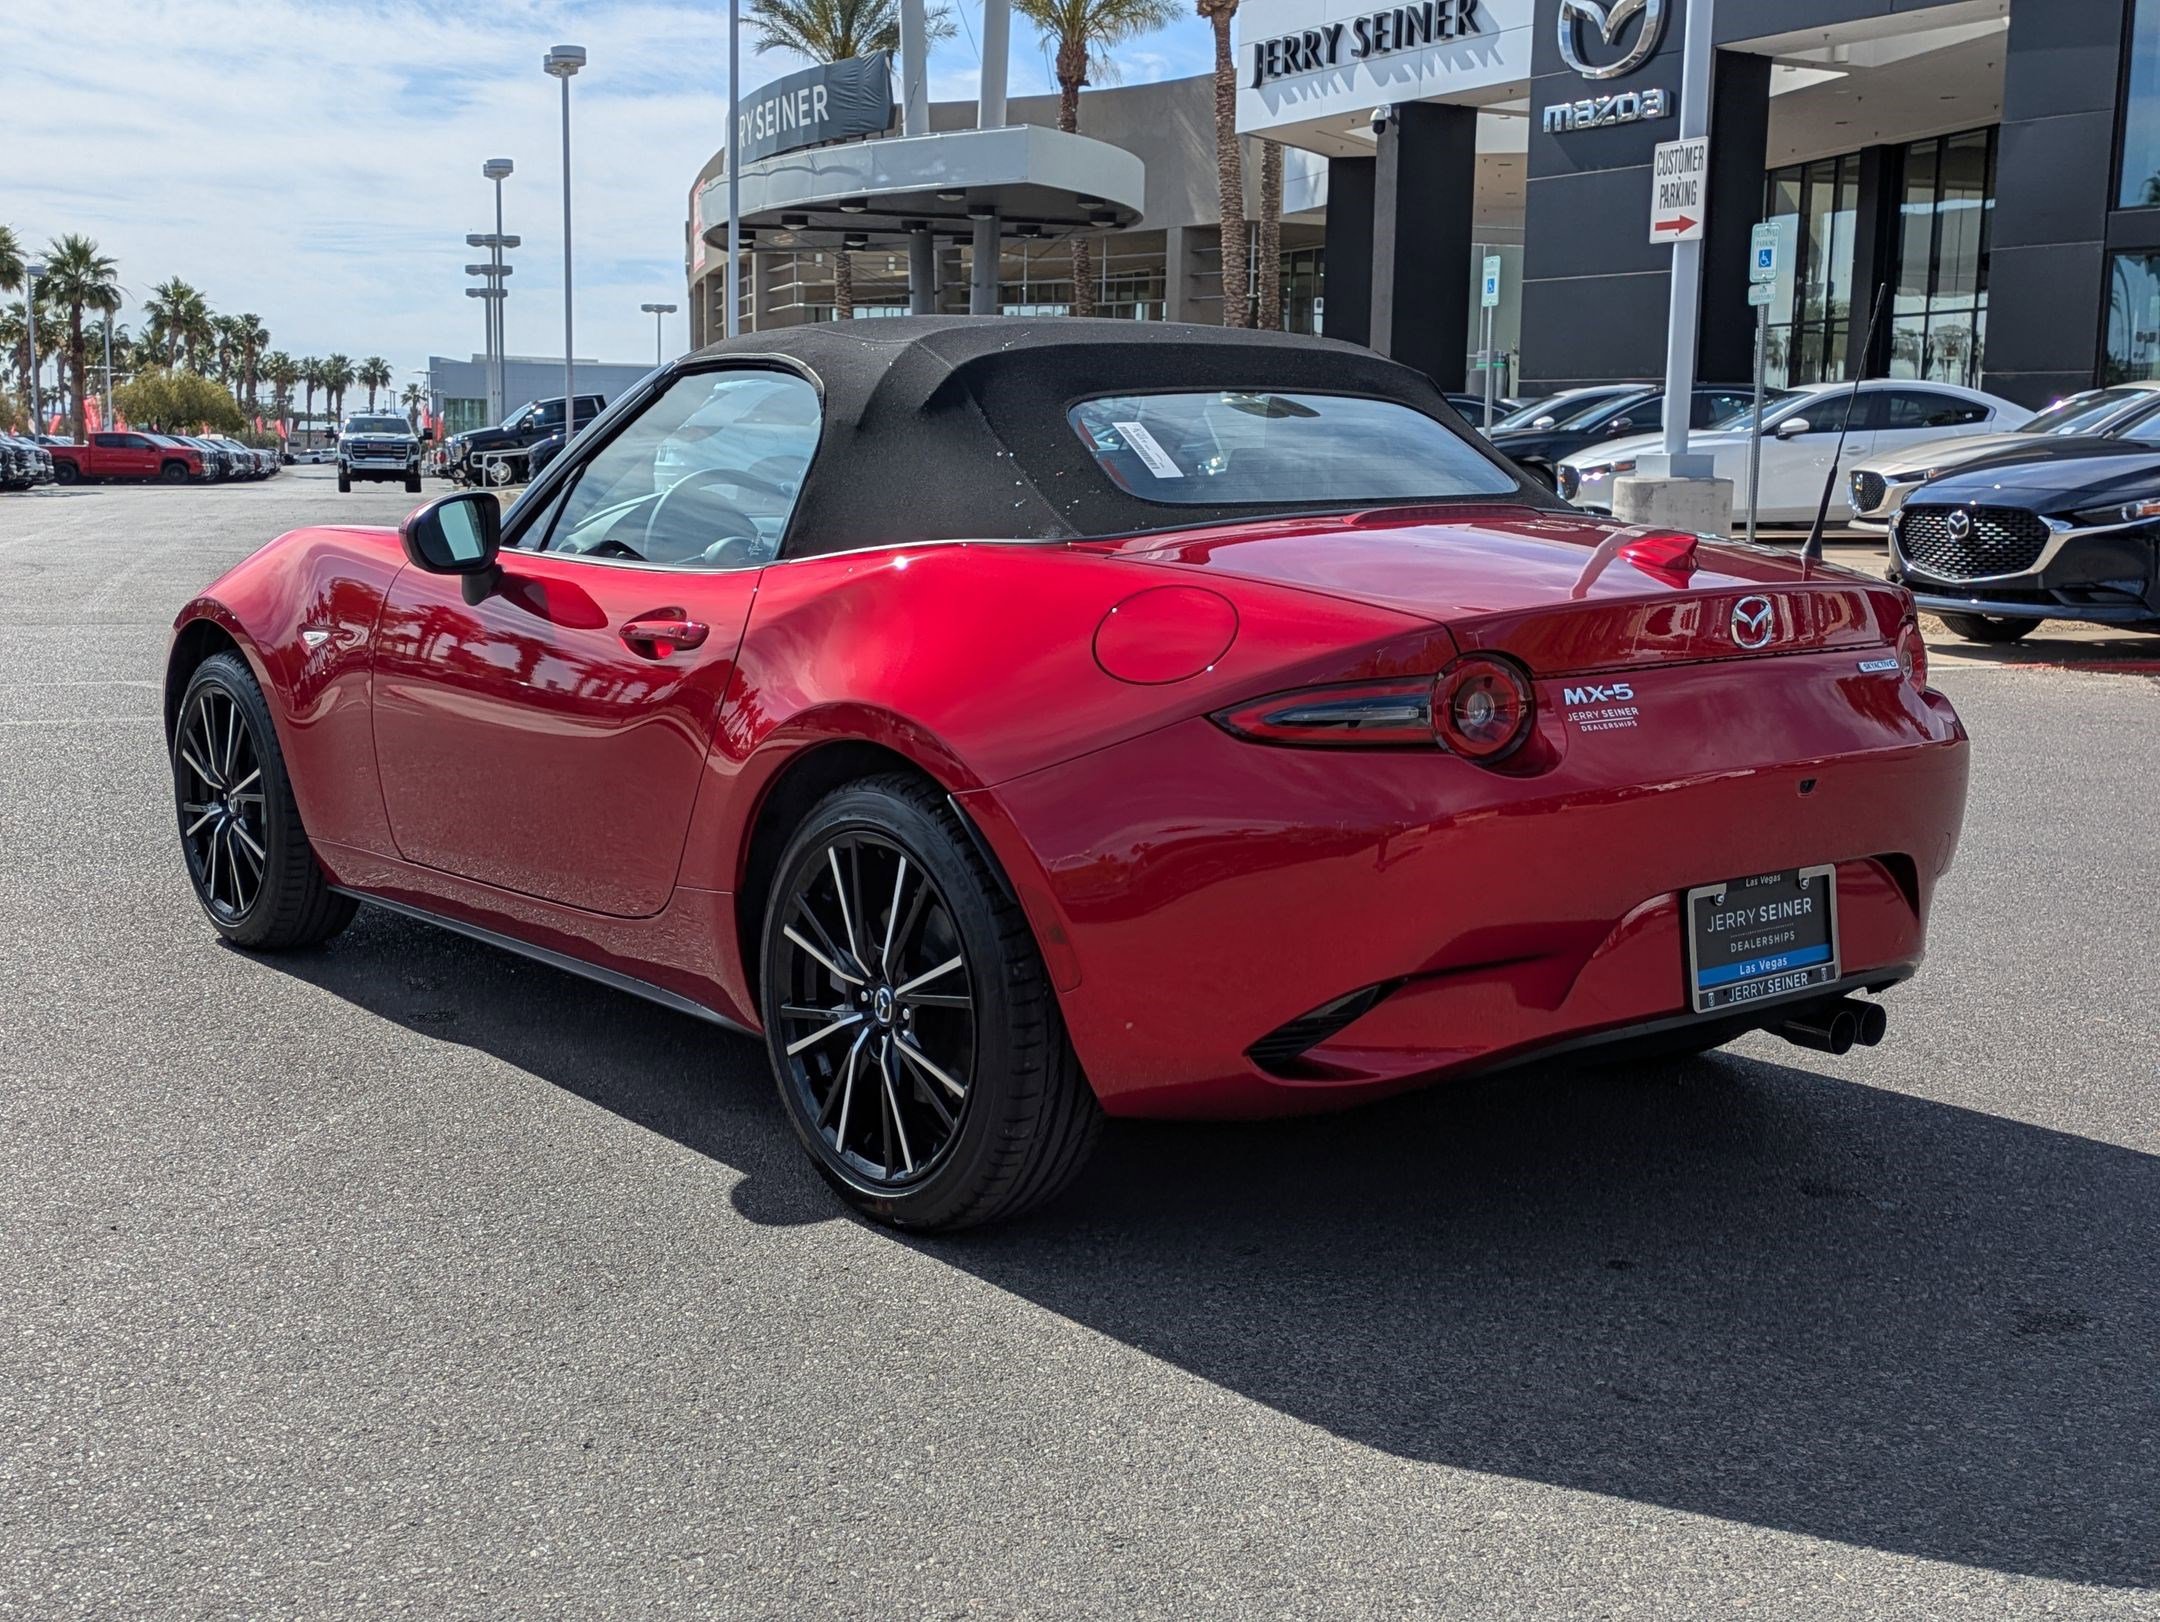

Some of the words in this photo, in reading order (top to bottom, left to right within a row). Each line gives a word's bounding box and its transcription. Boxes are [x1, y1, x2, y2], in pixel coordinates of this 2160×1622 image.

[1250, 23, 1344, 88] JERRY
[1351, 0, 1481, 58] SEINER
[756, 84, 830, 140] SEINER
[1656, 144, 1704, 176] CUSTOMER
[1659, 180, 1698, 209] PARKING
[1563, 683, 1634, 706] MX-5
[1568, 710, 1600, 722] JERRY
[1601, 707, 1639, 718] SEINER
[1581, 720, 1637, 732] DEALERSHIPS
[1745, 878, 1758, 888] Las
[1760, 873, 1781, 885] Vegas
[1707, 908, 1756, 933] JERRY
[1759, 897, 1812, 922] SEINER
[1730, 930, 1795, 953] DEALERSHIPS
[1740, 964, 1756, 975] Las
[1759, 957, 1787, 971] Vegas
[1729, 981, 1765, 1002] JERRY
[1767, 972, 1808, 993] SEINER
